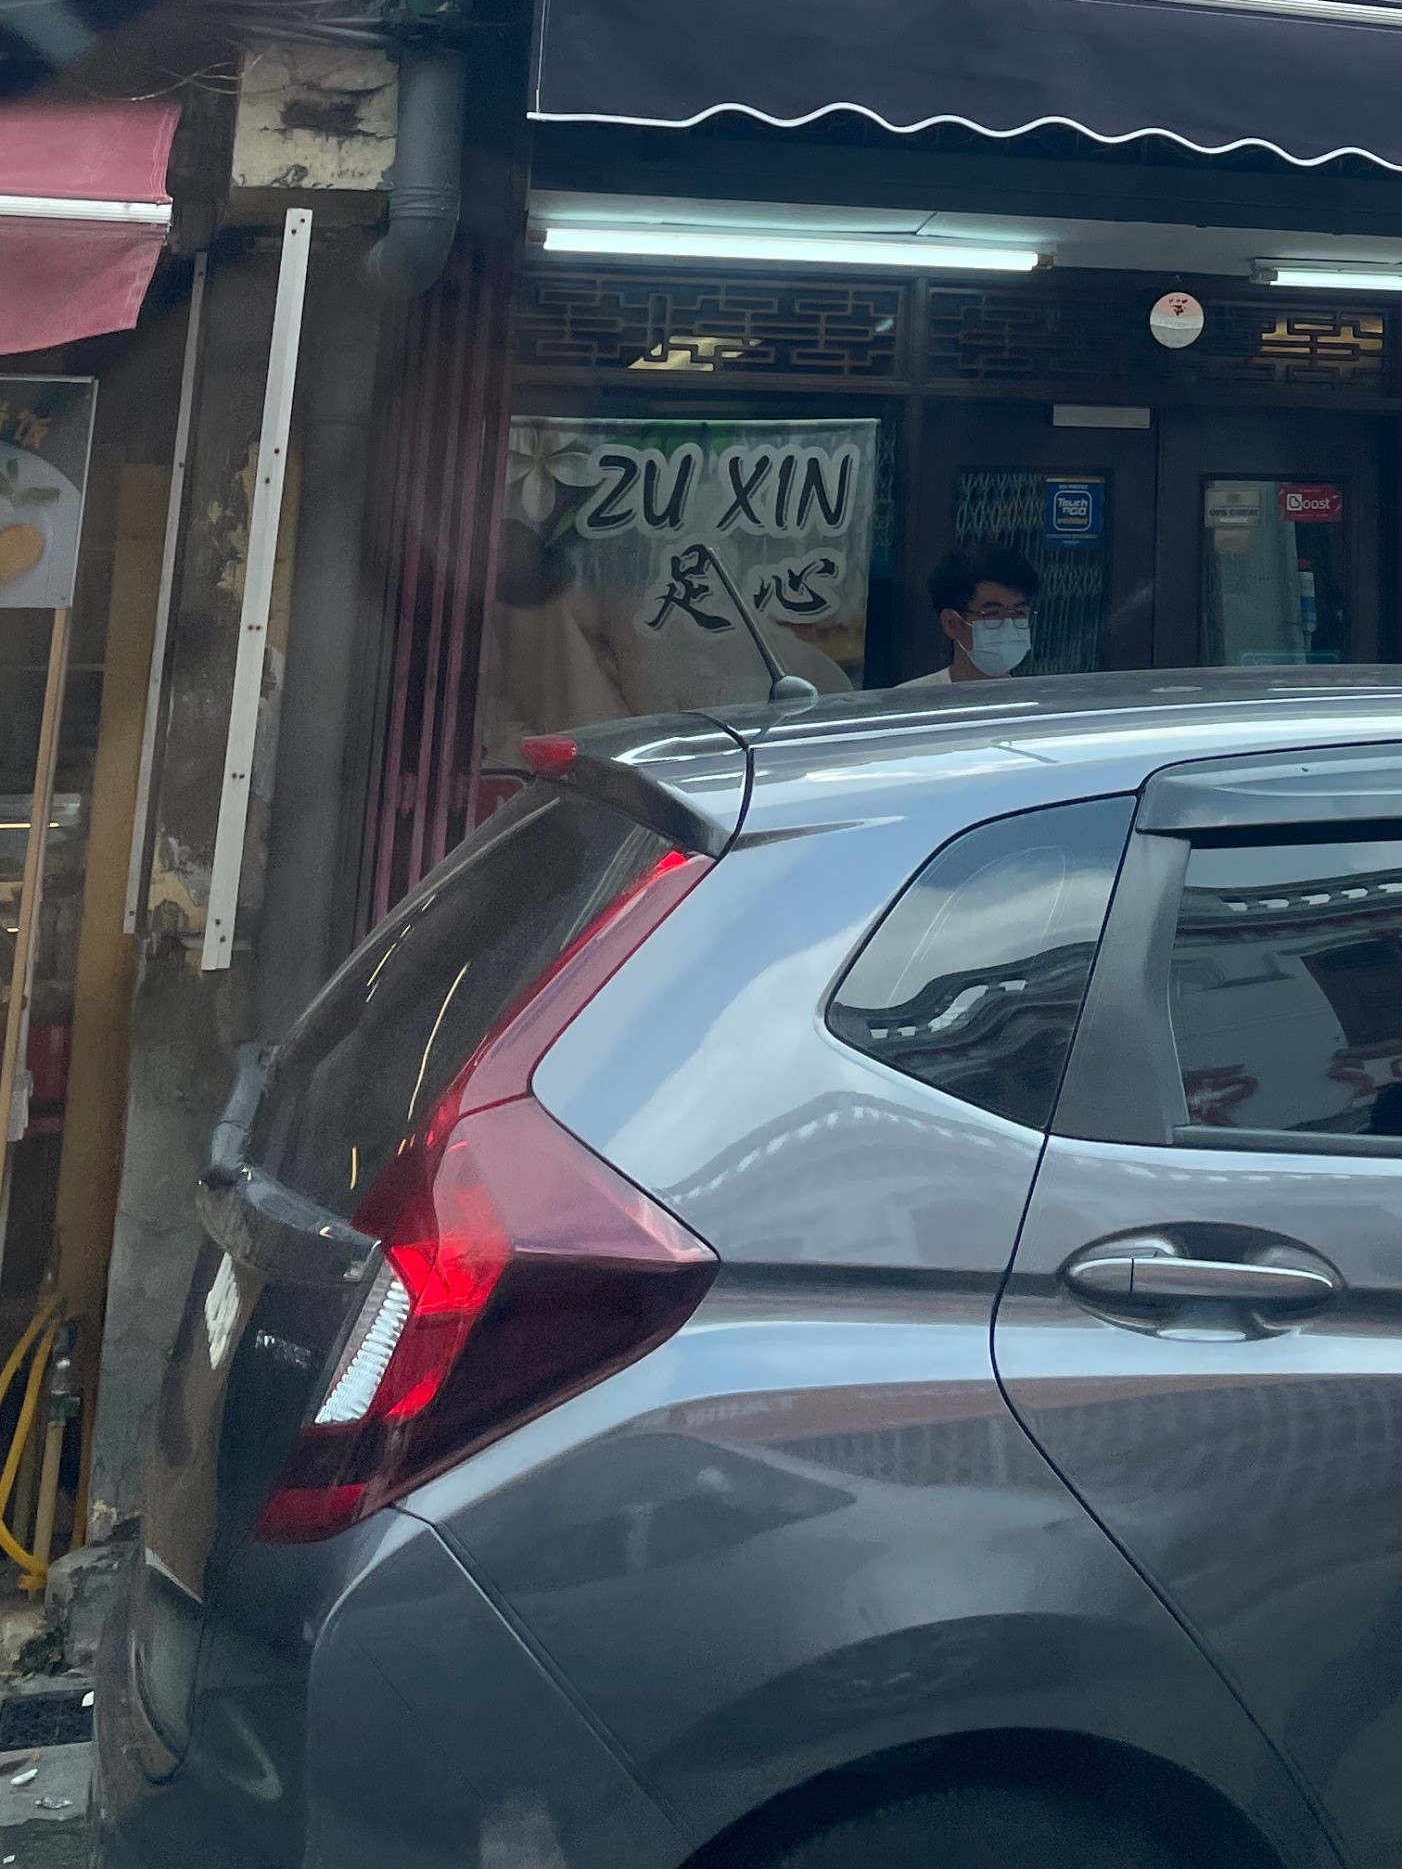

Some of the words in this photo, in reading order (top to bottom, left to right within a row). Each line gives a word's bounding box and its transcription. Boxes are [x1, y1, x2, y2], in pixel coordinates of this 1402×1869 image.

[587, 453, 698, 531] ZU
[717, 453, 854, 531] XIN
[646, 543, 839, 631] 足心
